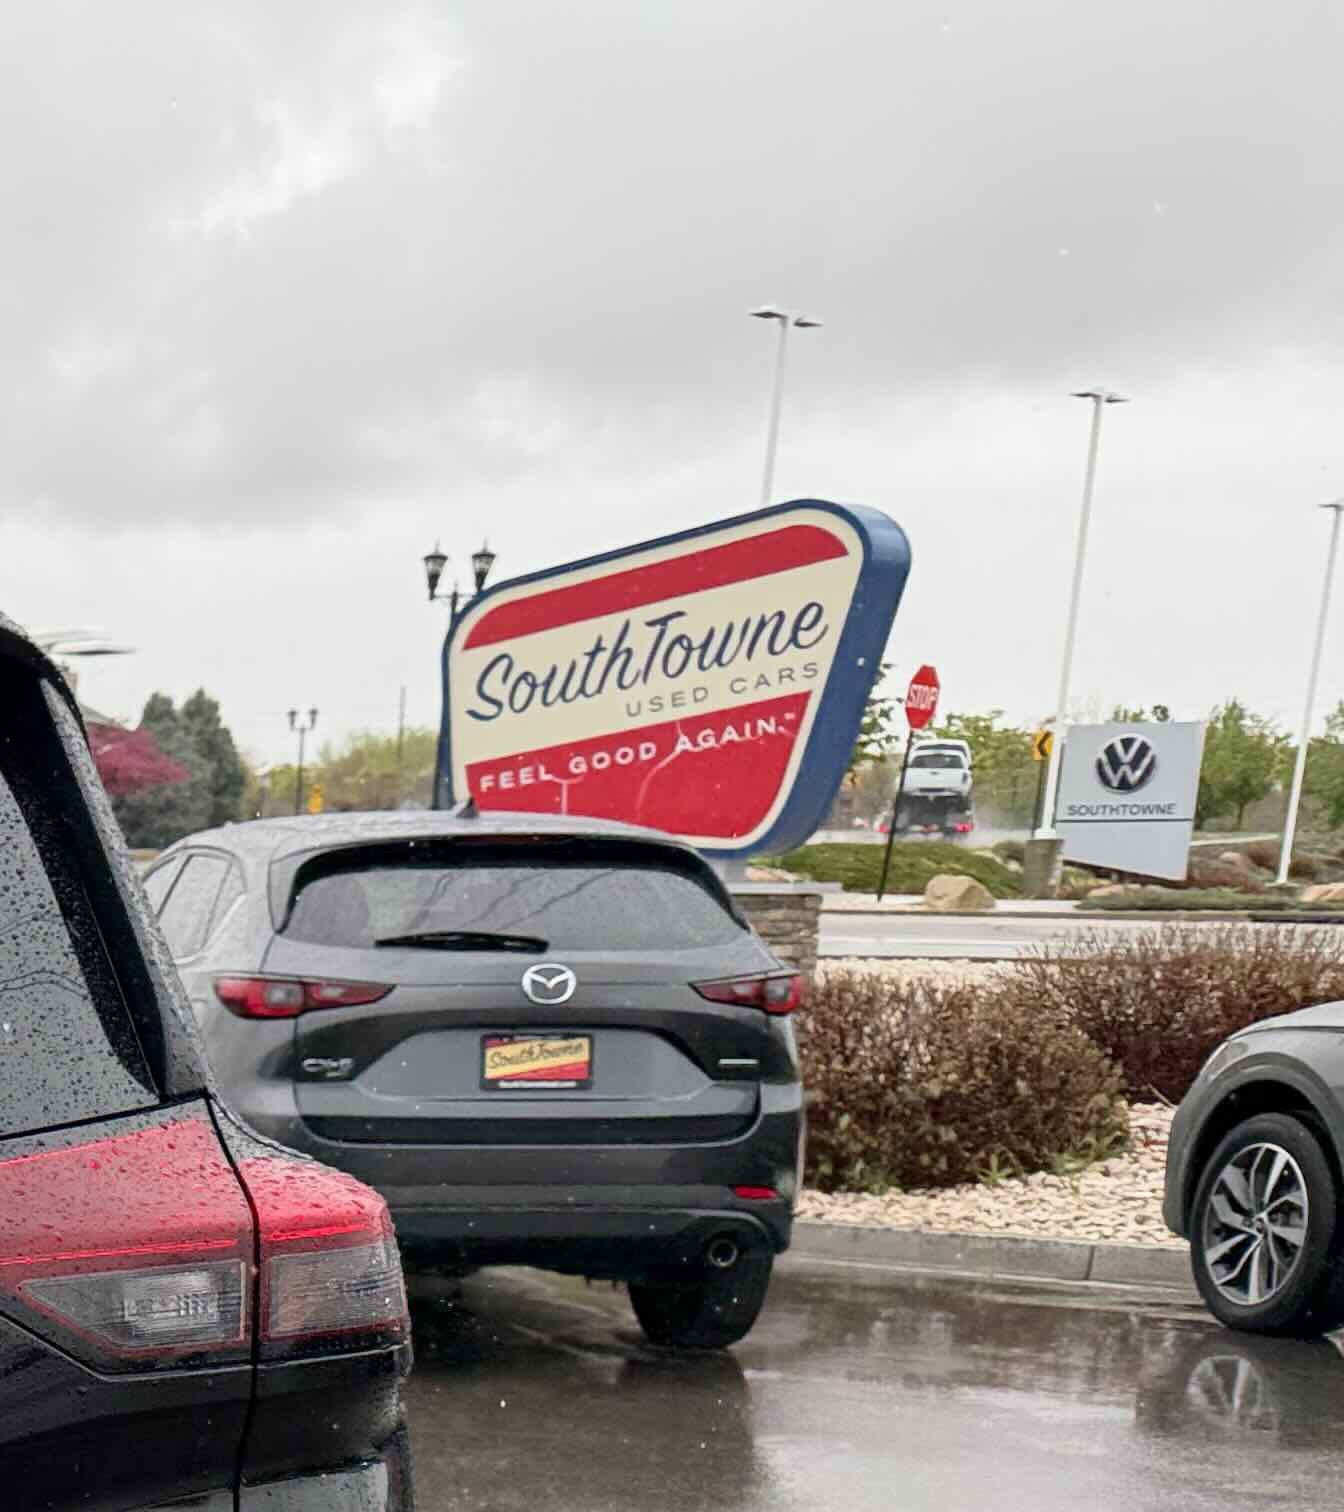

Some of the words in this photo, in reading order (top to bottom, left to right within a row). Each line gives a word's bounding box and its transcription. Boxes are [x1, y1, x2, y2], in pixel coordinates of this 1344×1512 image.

[466, 601, 829, 721] SouthTowne
[626, 687, 709, 718] USED
[730, 662, 819, 695] CARS
[907, 683, 937, 710] STOP
[480, 764, 553, 792] FEEL
[568, 742, 657, 775] GOOD
[1066, 803, 1177, 816] SOUTHTOWNE
